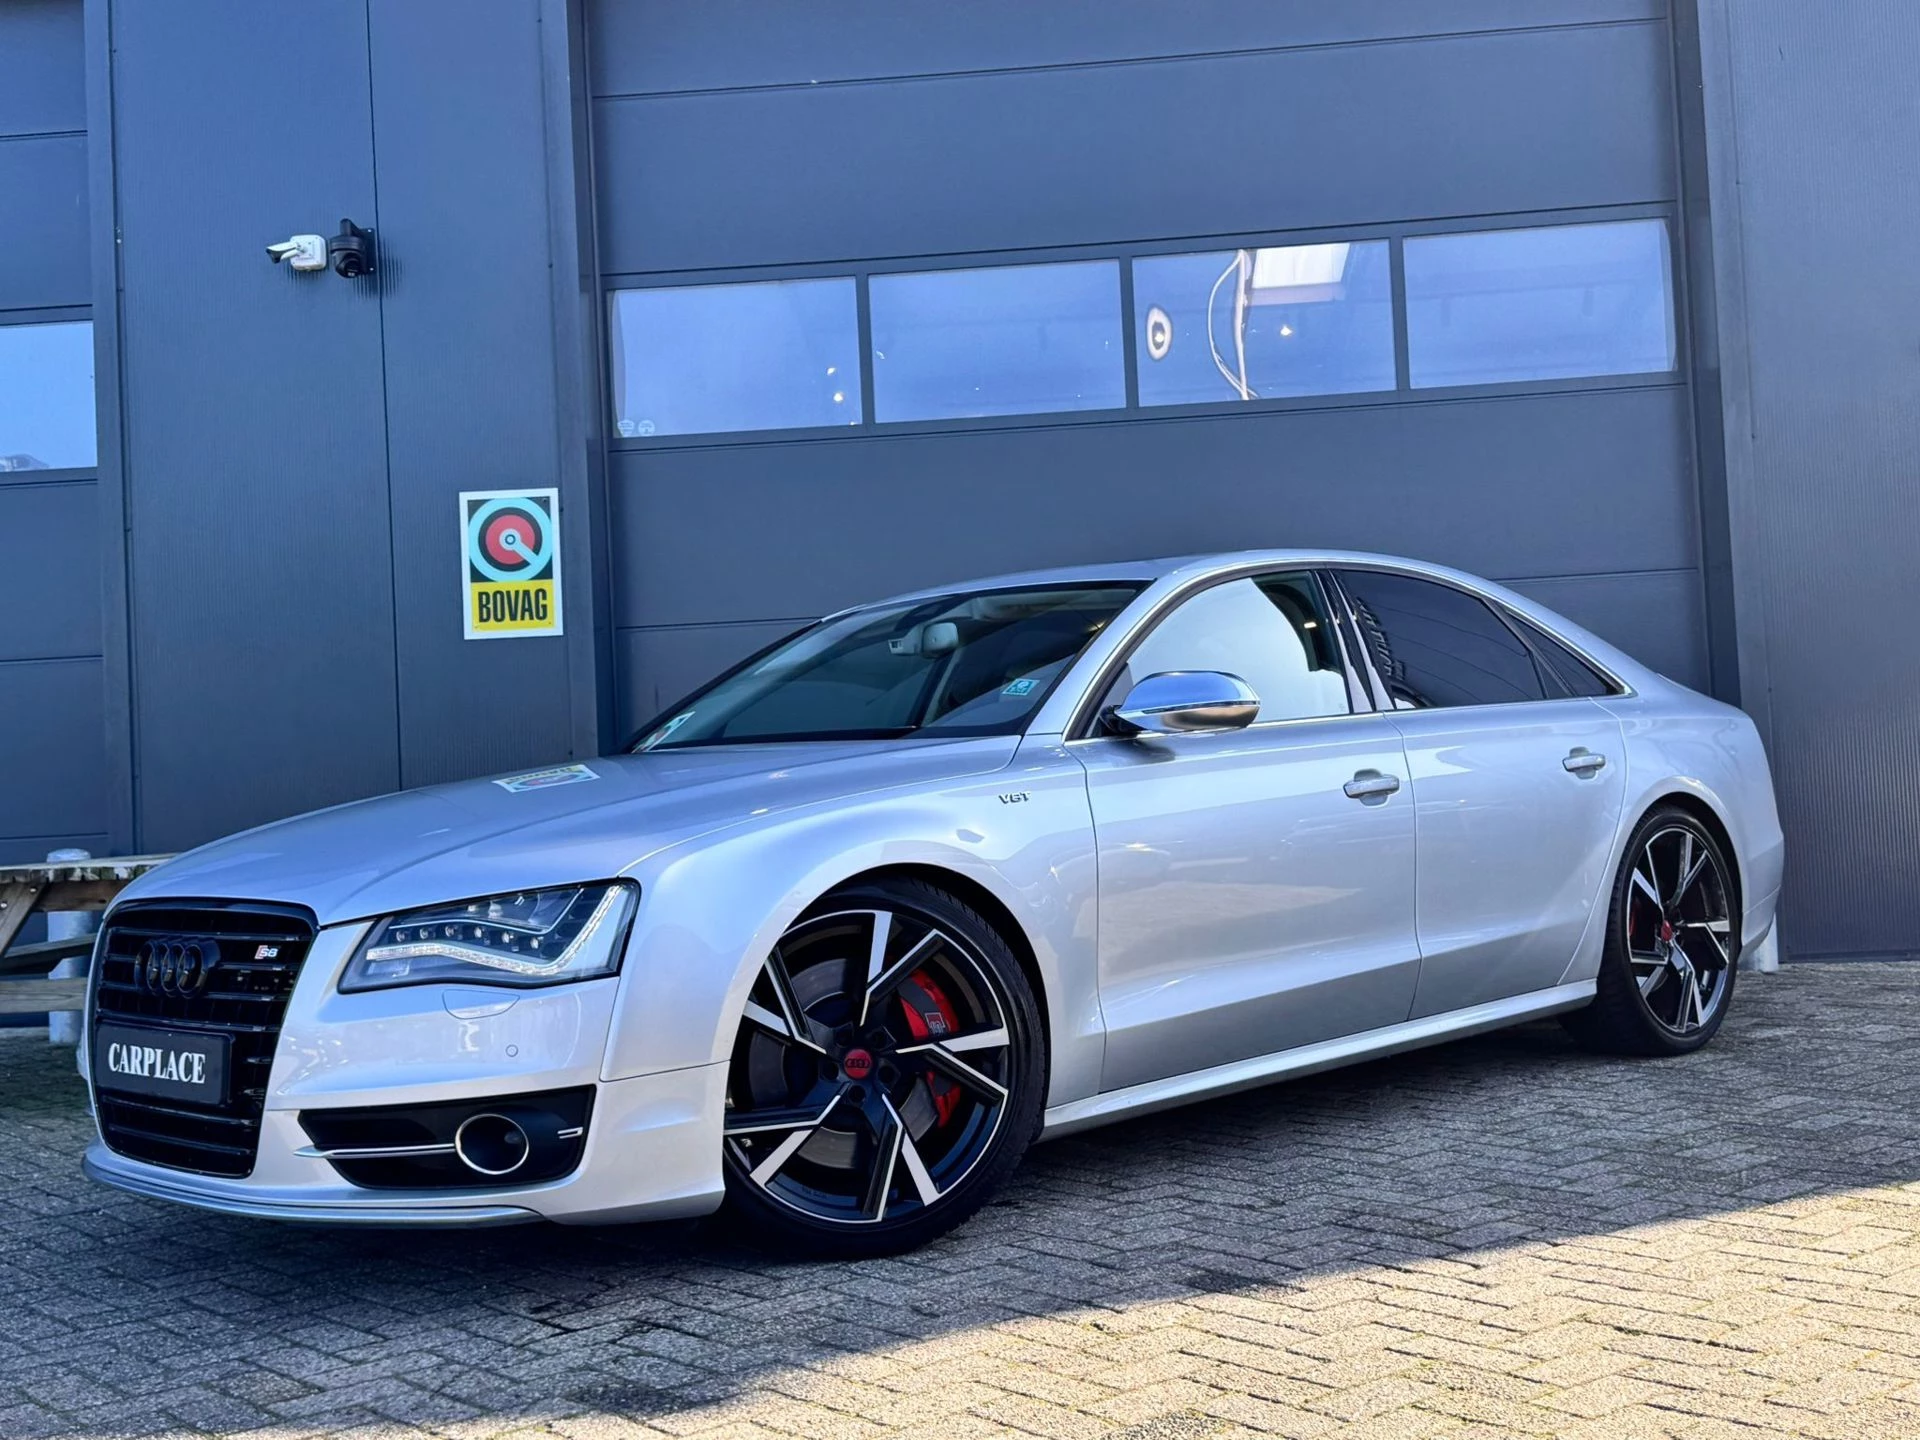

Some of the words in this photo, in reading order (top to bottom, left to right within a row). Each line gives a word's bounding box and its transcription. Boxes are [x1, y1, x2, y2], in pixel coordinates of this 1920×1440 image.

[478, 587, 548, 623] BOVAG
[258, 946, 279, 959] S8
[108, 1043, 206, 1083] CARPLACE
